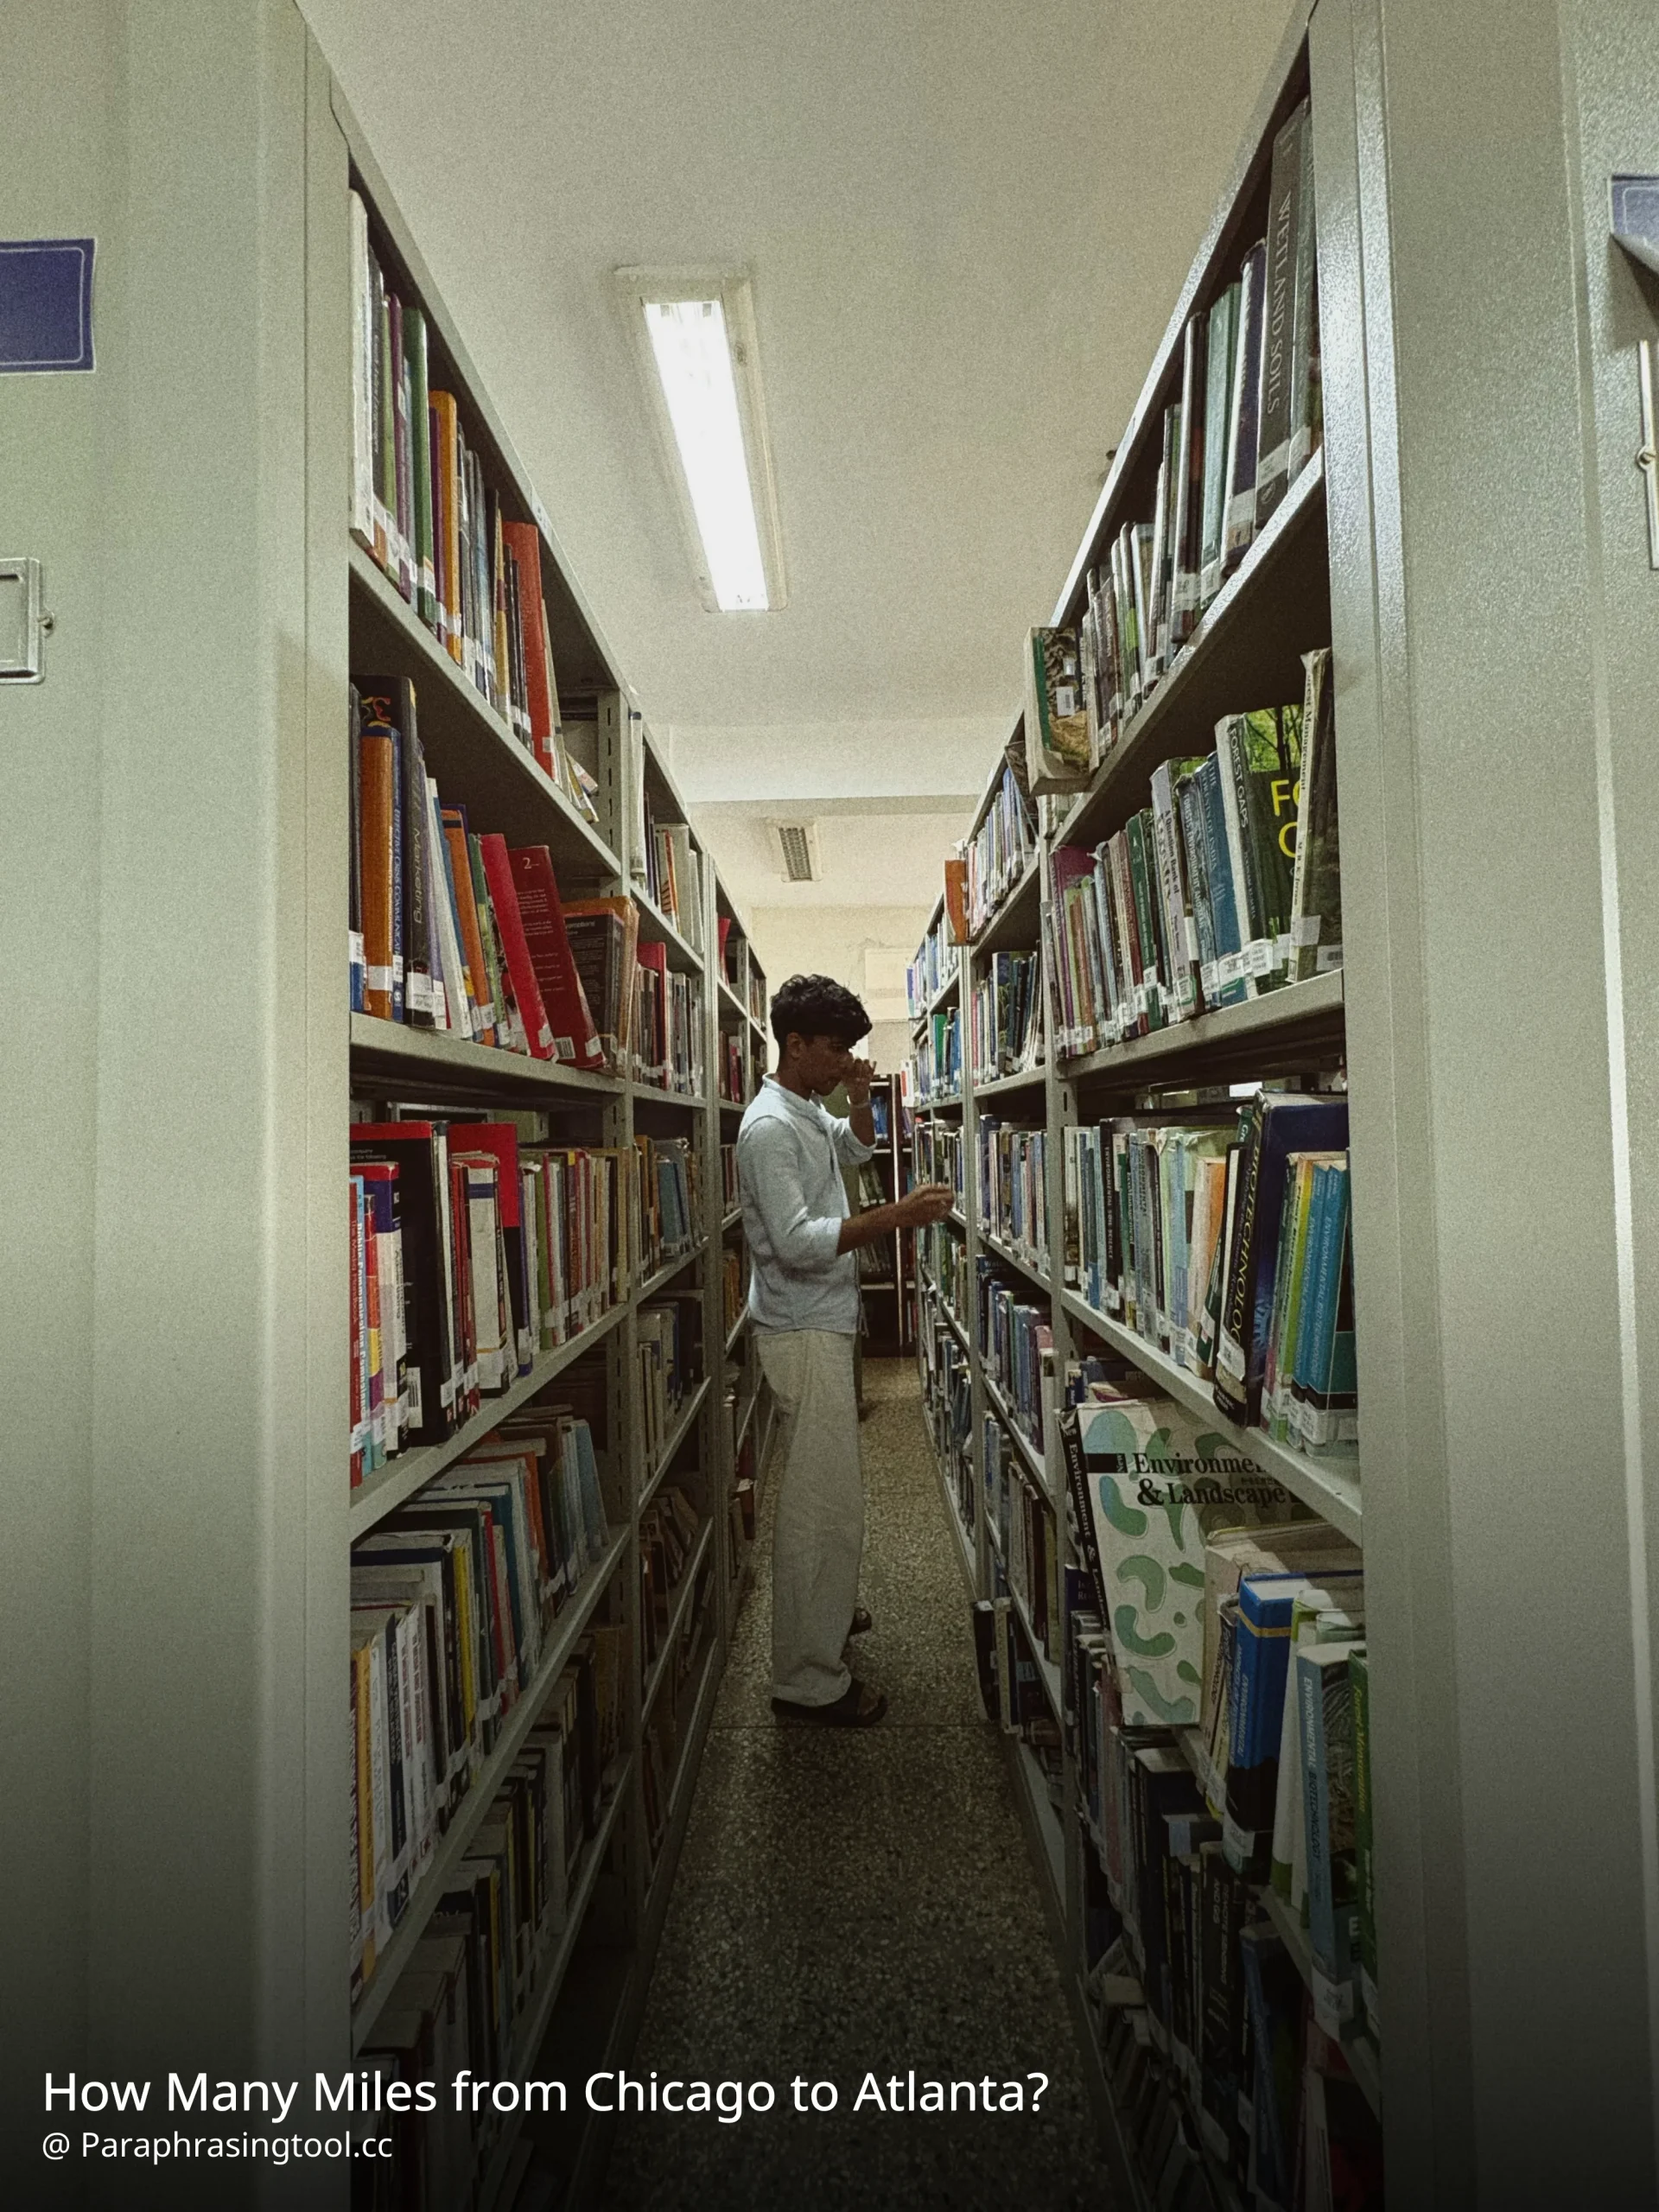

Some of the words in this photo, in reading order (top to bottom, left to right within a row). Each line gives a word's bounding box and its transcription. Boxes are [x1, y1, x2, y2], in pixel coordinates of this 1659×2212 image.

[1271, 191, 1292, 336] WETLAND
[1267, 340, 1282, 414] SOILS
[1229, 727, 1243, 782] FOREST
[1236, 785, 1249, 828] GAPS
[1301, 710, 1312, 790] Management
[412, 827, 423, 924] Marketing
[1165, 817, 1176, 858] Question
[1186, 830, 1200, 888] ENVIRONMENT
[1230, 1145, 1260, 1345] BIOTECHNOLO
[1301, 1217, 1316, 1297] ENVIRONMENTAL
[1317, 1215, 1332, 1298] ENVIRONMENTAL
[1068, 1442, 1091, 1539] Environment
[1132, 1452, 1266, 1475] Environme
[1136, 1478, 1165, 1507] &
[1167, 1483, 1286, 1510] Landscape
[1236, 1672, 1250, 1758] ENVIRONMENTAL
[1304, 1675, 1316, 1768] ENVIRONMENTAL
[1353, 1684, 1363, 1727] Forest
[1307, 1770, 1320, 1860] BIOTECHNOLOGY
[1220, 1883, 1229, 1931] REMOTE
[1219, 1933, 1228, 1986] SENSING
